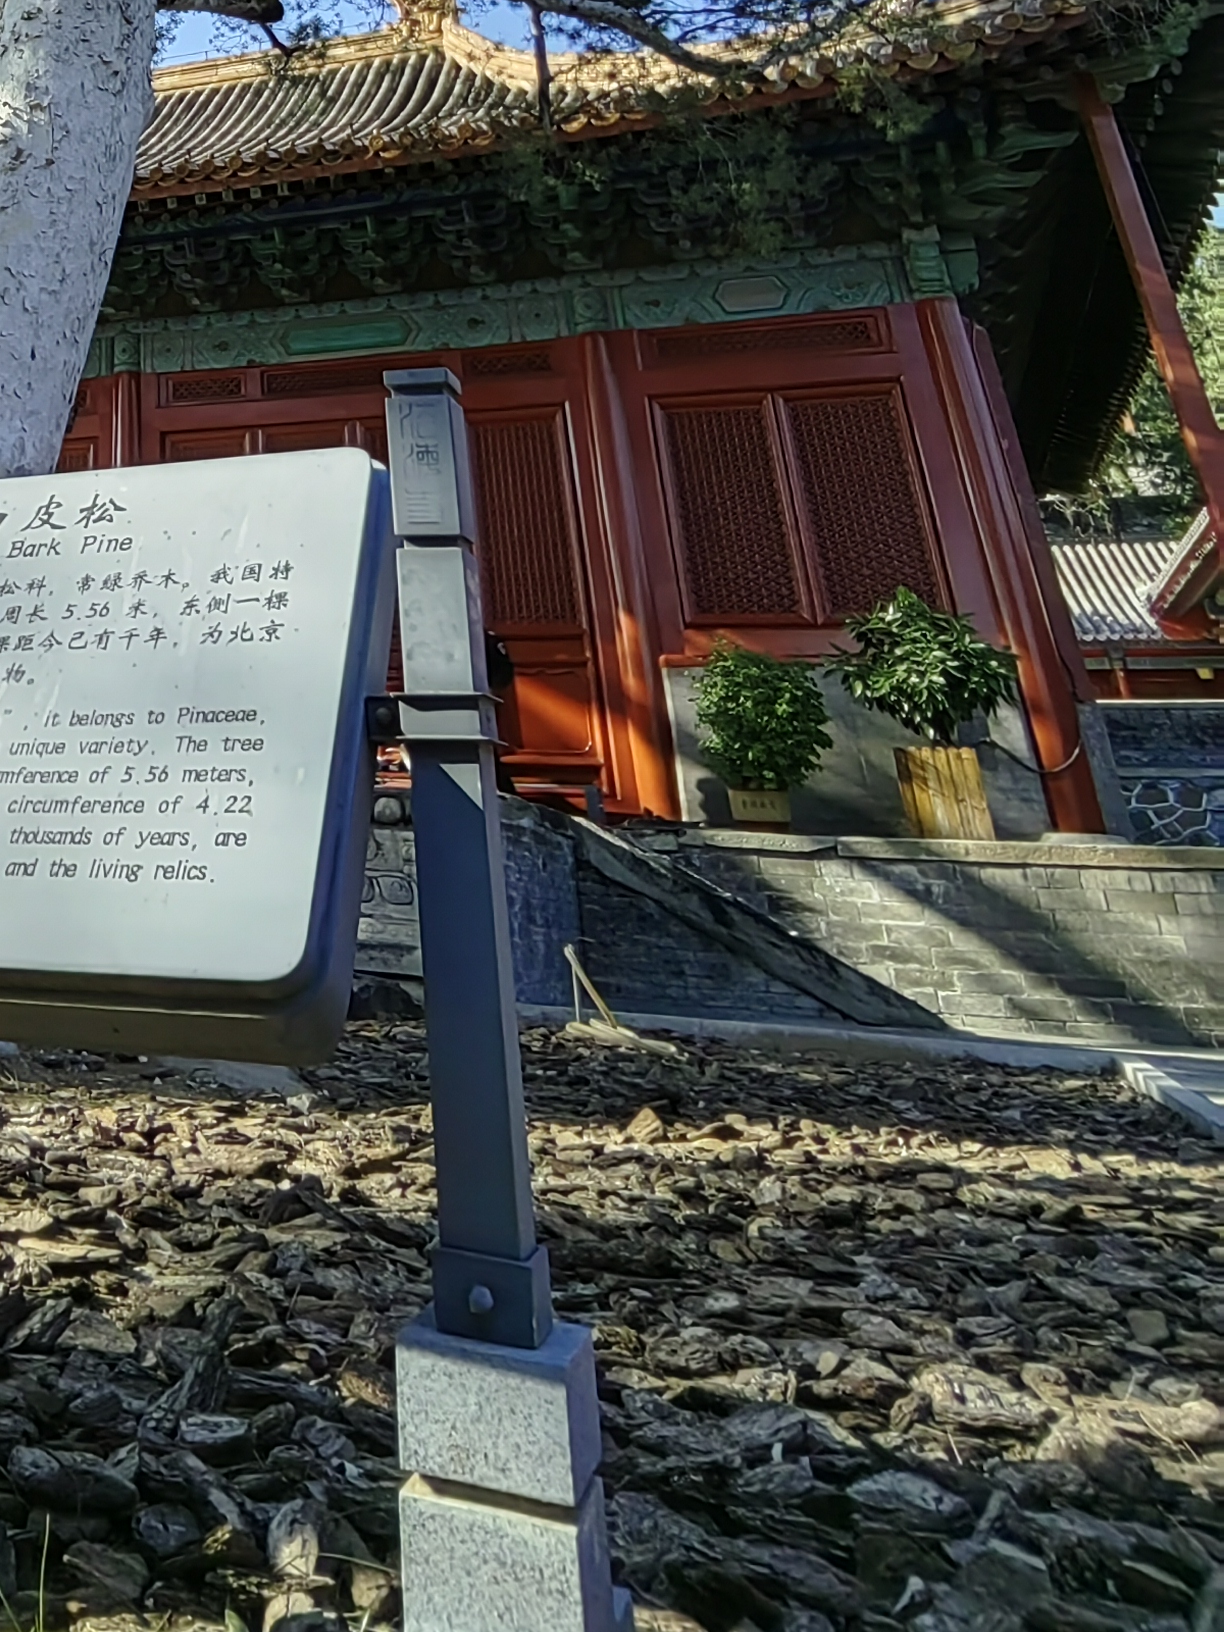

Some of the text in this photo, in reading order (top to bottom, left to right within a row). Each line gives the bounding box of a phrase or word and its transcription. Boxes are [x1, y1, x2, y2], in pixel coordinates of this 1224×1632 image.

[6, 537, 62, 558] Bark
[80, 534, 133, 554] Pine
[61, 601, 110, 620] 5.56
[44, 710, 59, 727] it
[69, 710, 135, 728] belongs
[147, 710, 165, 724] to
[177, 706, 265, 726] Pinaceae,
[9, 738, 65, 758] unique
[79, 736, 155, 756] variety.
[176, 735, 208, 752] The
[222, 736, 264, 752] tree
[89, 765, 112, 783] of
[120, 765, 169, 785] 5.56
[181, 766, 254, 787] meters,
[7, 795, 145, 815] circumference
[158, 795, 183, 814] of
[196, 795, 252, 816] 4.22
[10, 826, 92, 845] thousands
[103, 827, 127, 845] of
[135, 829, 197, 851] years,
[214, 831, 247, 847] are
[5, 858, 39, 877] and
[49, 858, 77, 878] the
[89, 858, 143, 882] living
[153, 859, 215, 883] relics.
